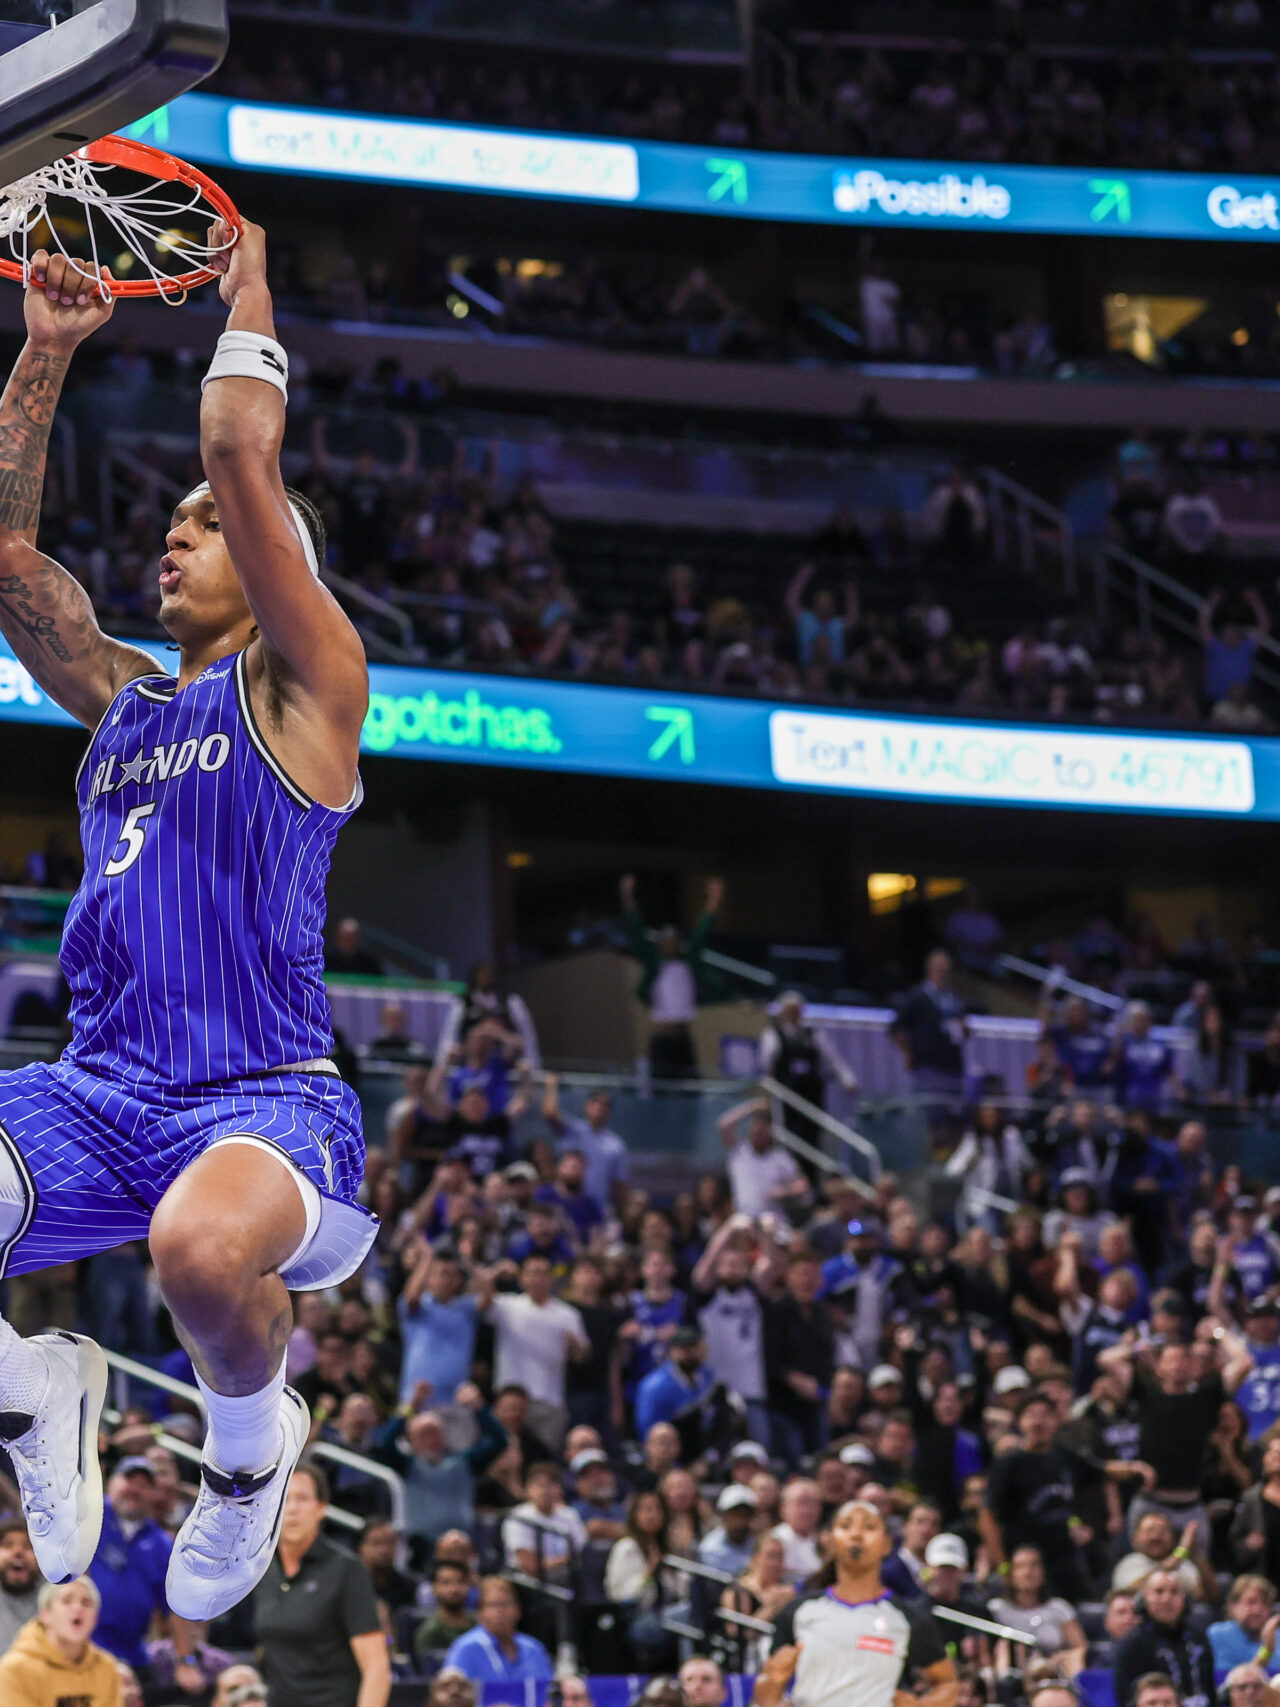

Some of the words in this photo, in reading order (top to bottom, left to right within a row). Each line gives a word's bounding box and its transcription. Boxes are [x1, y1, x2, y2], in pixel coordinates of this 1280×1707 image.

[1206, 185, 1280, 230] Get
[362, 688, 563, 754] gotchas.
[86, 732, 232, 811] RLANDO
[1052, 751, 1099, 792] to
[104, 801, 156, 877] 5
